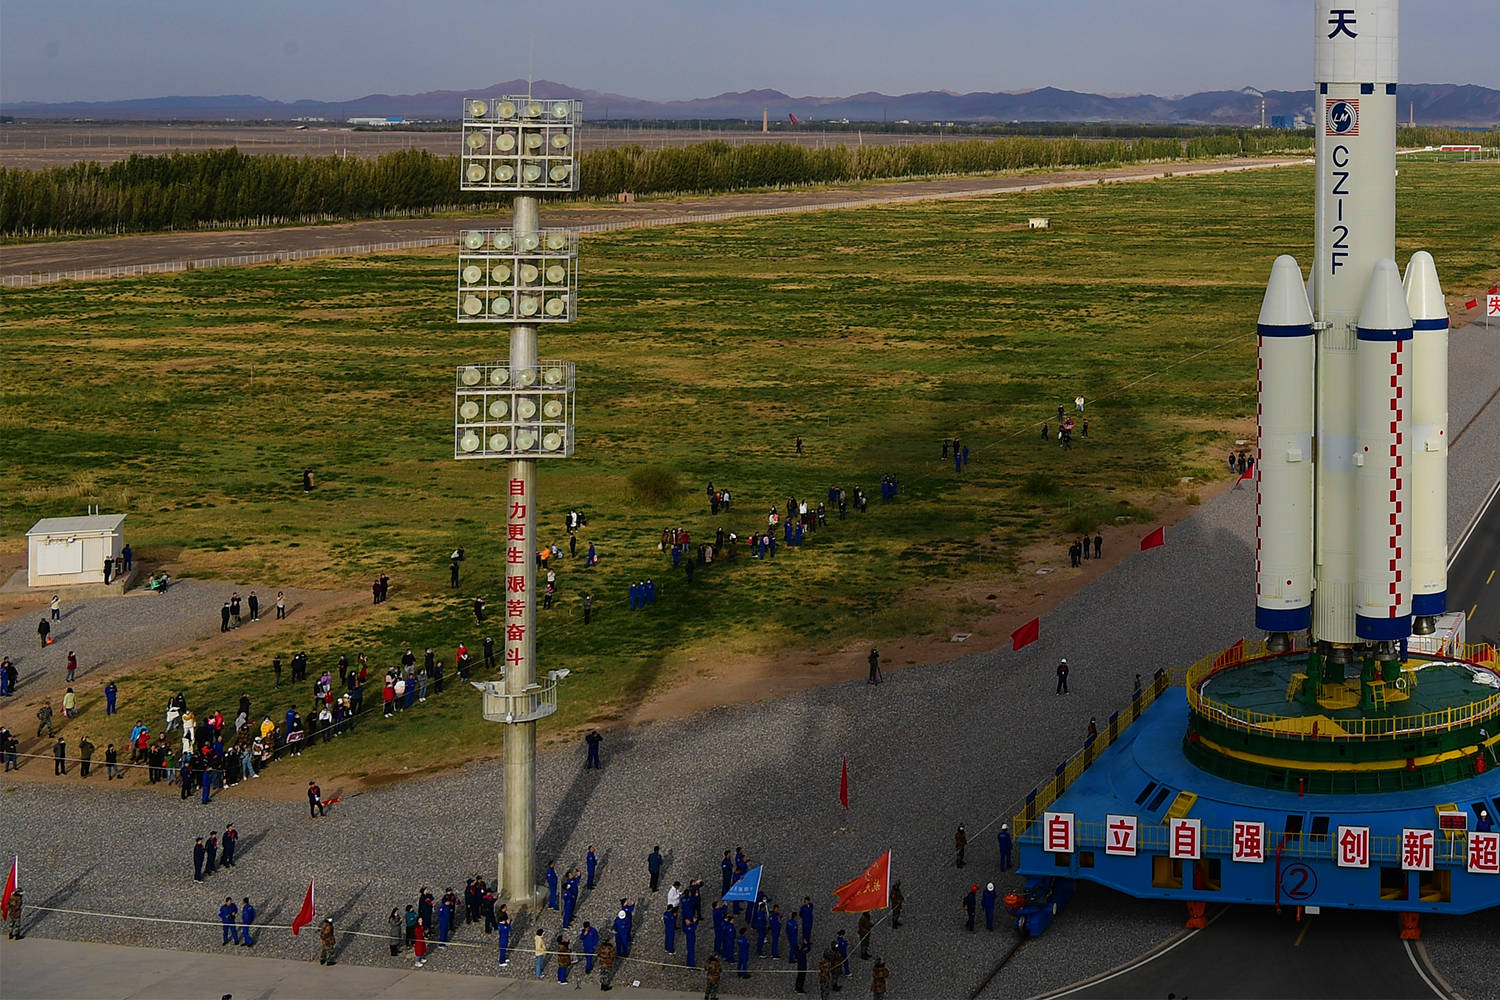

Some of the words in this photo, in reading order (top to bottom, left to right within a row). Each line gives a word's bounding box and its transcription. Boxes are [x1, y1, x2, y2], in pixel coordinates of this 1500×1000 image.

[1334, 113, 1349, 122] LM
[507, 478, 527, 565] 自力更生
[506, 575, 526, 667] 艰苦奋斗
[1049, 815, 1262, 858] 自立自强
